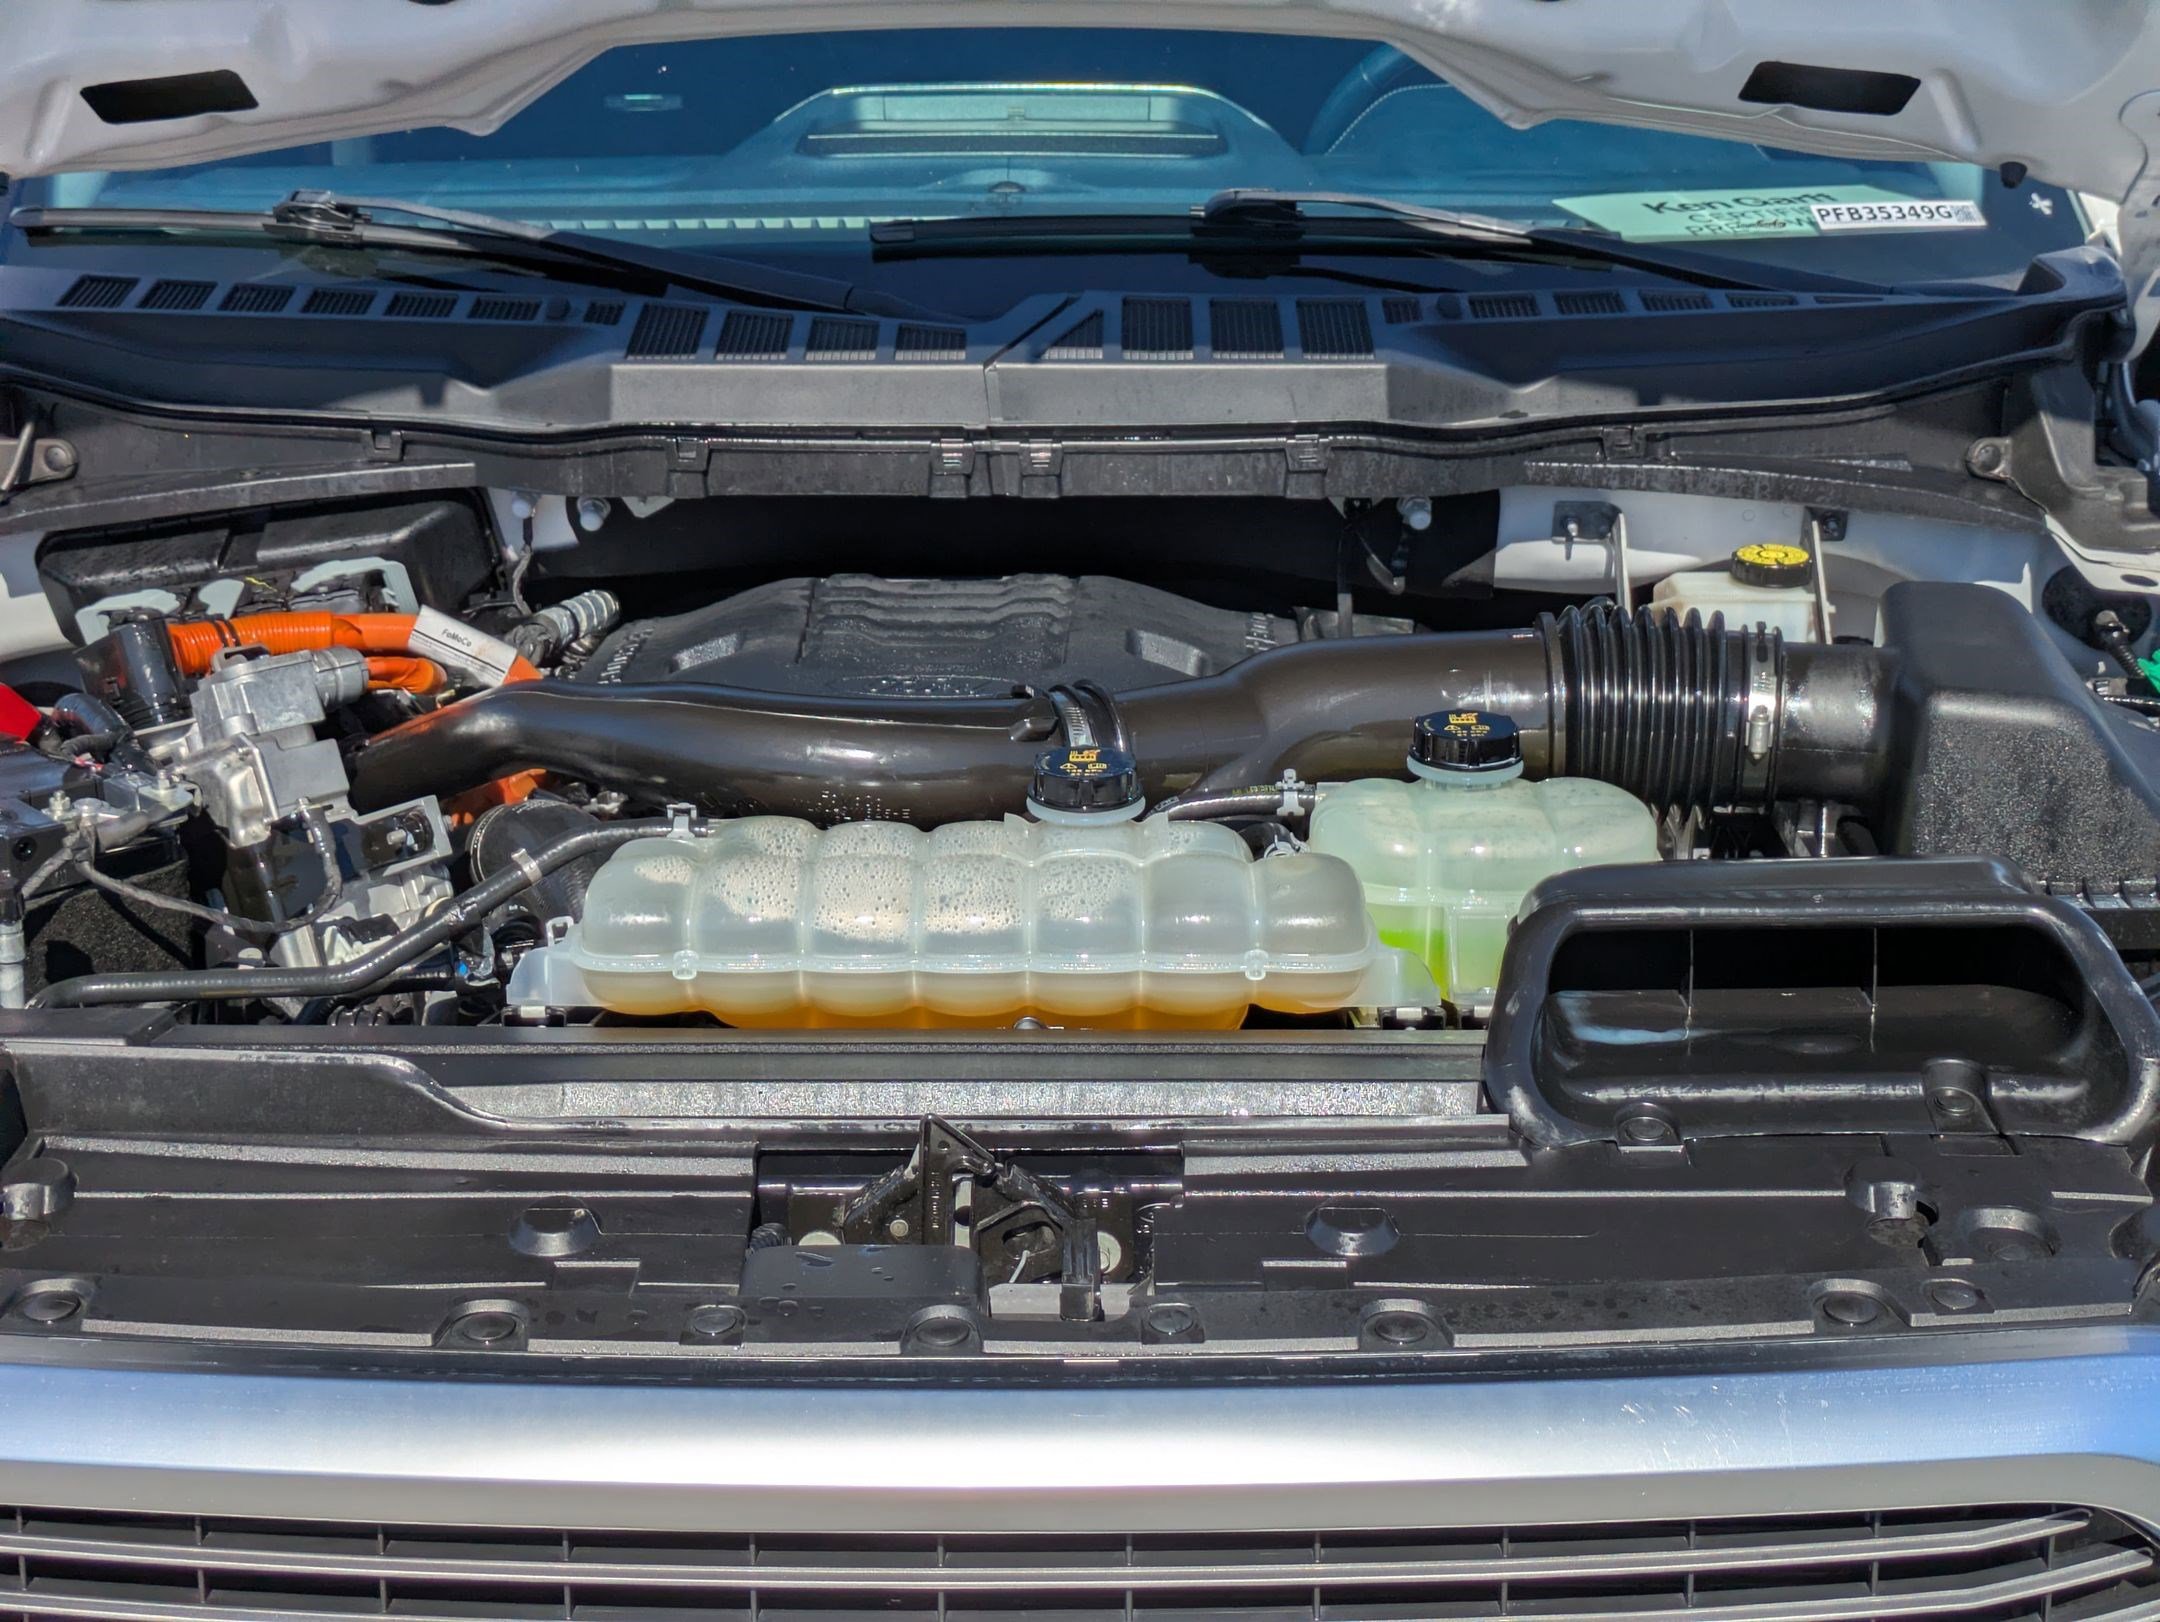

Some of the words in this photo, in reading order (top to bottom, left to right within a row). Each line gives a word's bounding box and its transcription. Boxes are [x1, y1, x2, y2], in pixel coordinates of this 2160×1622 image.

[1643, 198, 1732, 214] Ken
[1816, 205, 1953, 222] PFB35349G
[441, 628, 472, 647] FoMoCo
